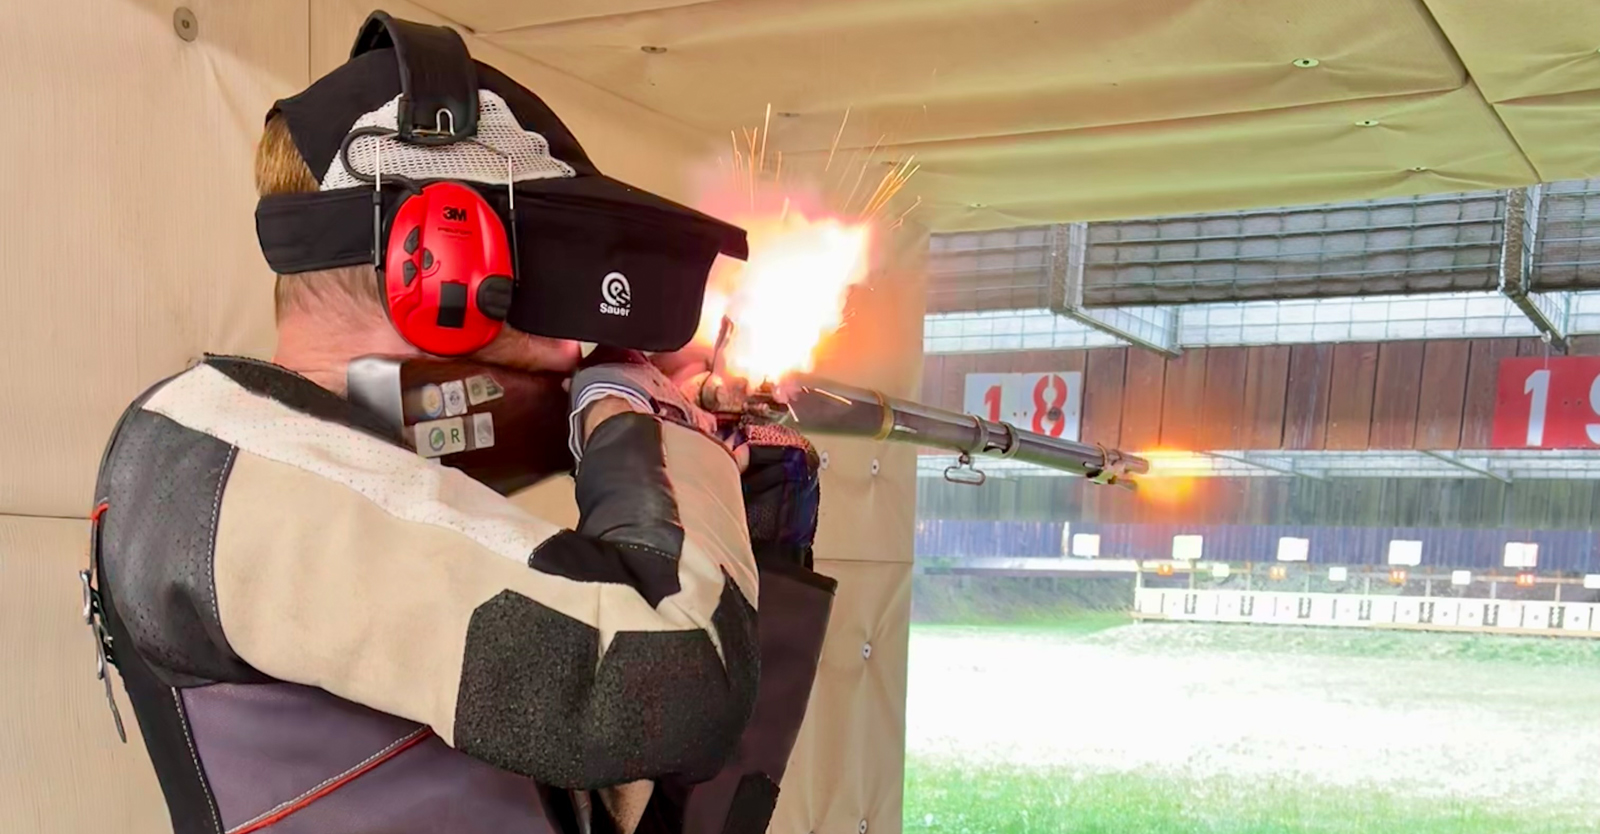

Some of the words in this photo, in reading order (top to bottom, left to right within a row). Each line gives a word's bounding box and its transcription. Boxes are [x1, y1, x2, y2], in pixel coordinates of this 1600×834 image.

[442, 206, 467, 222] 3M
[599, 302, 630, 317] Sauer
[984, 374, 1067, 438] 18
[450, 428, 461, 443] R
